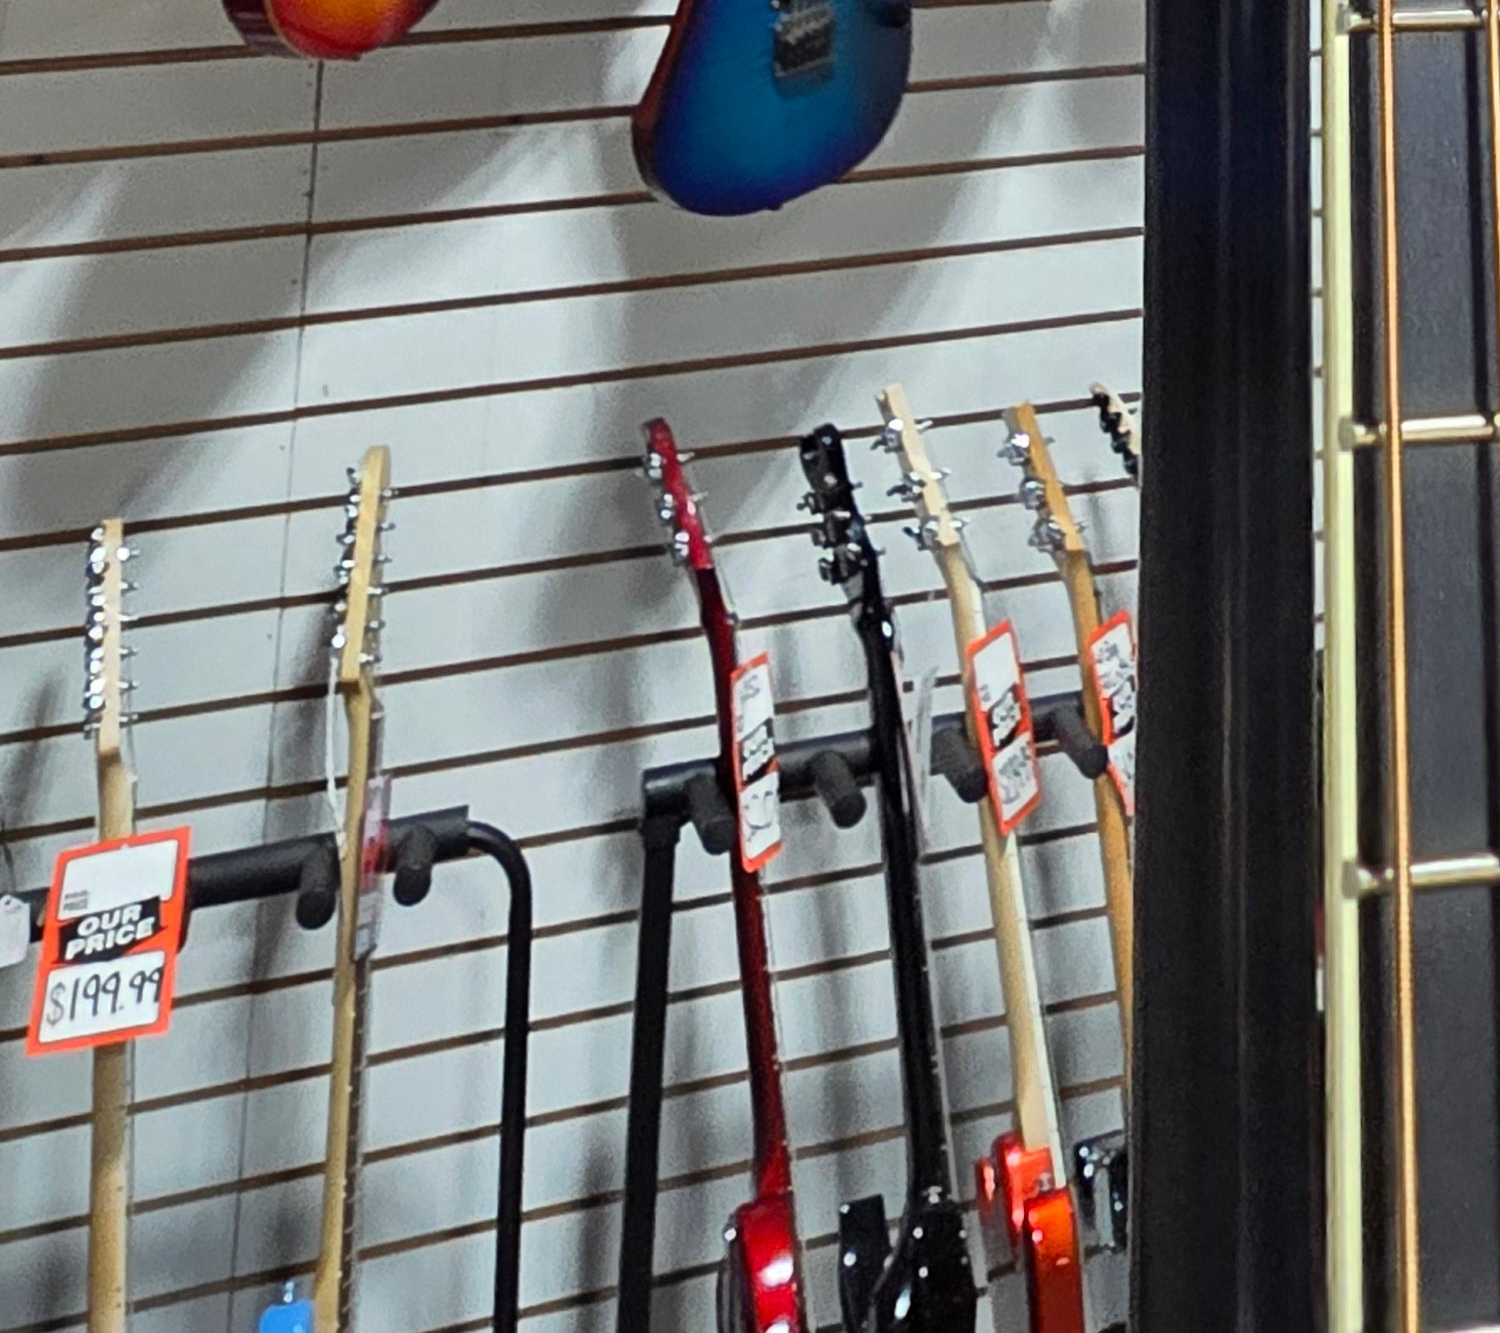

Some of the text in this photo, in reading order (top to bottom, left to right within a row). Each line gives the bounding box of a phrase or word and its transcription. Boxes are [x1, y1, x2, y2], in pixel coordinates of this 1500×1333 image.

[64, 917, 155, 961] PRICE
[77, 904, 143, 936] OUR
[45, 966, 164, 1026] $199.99
